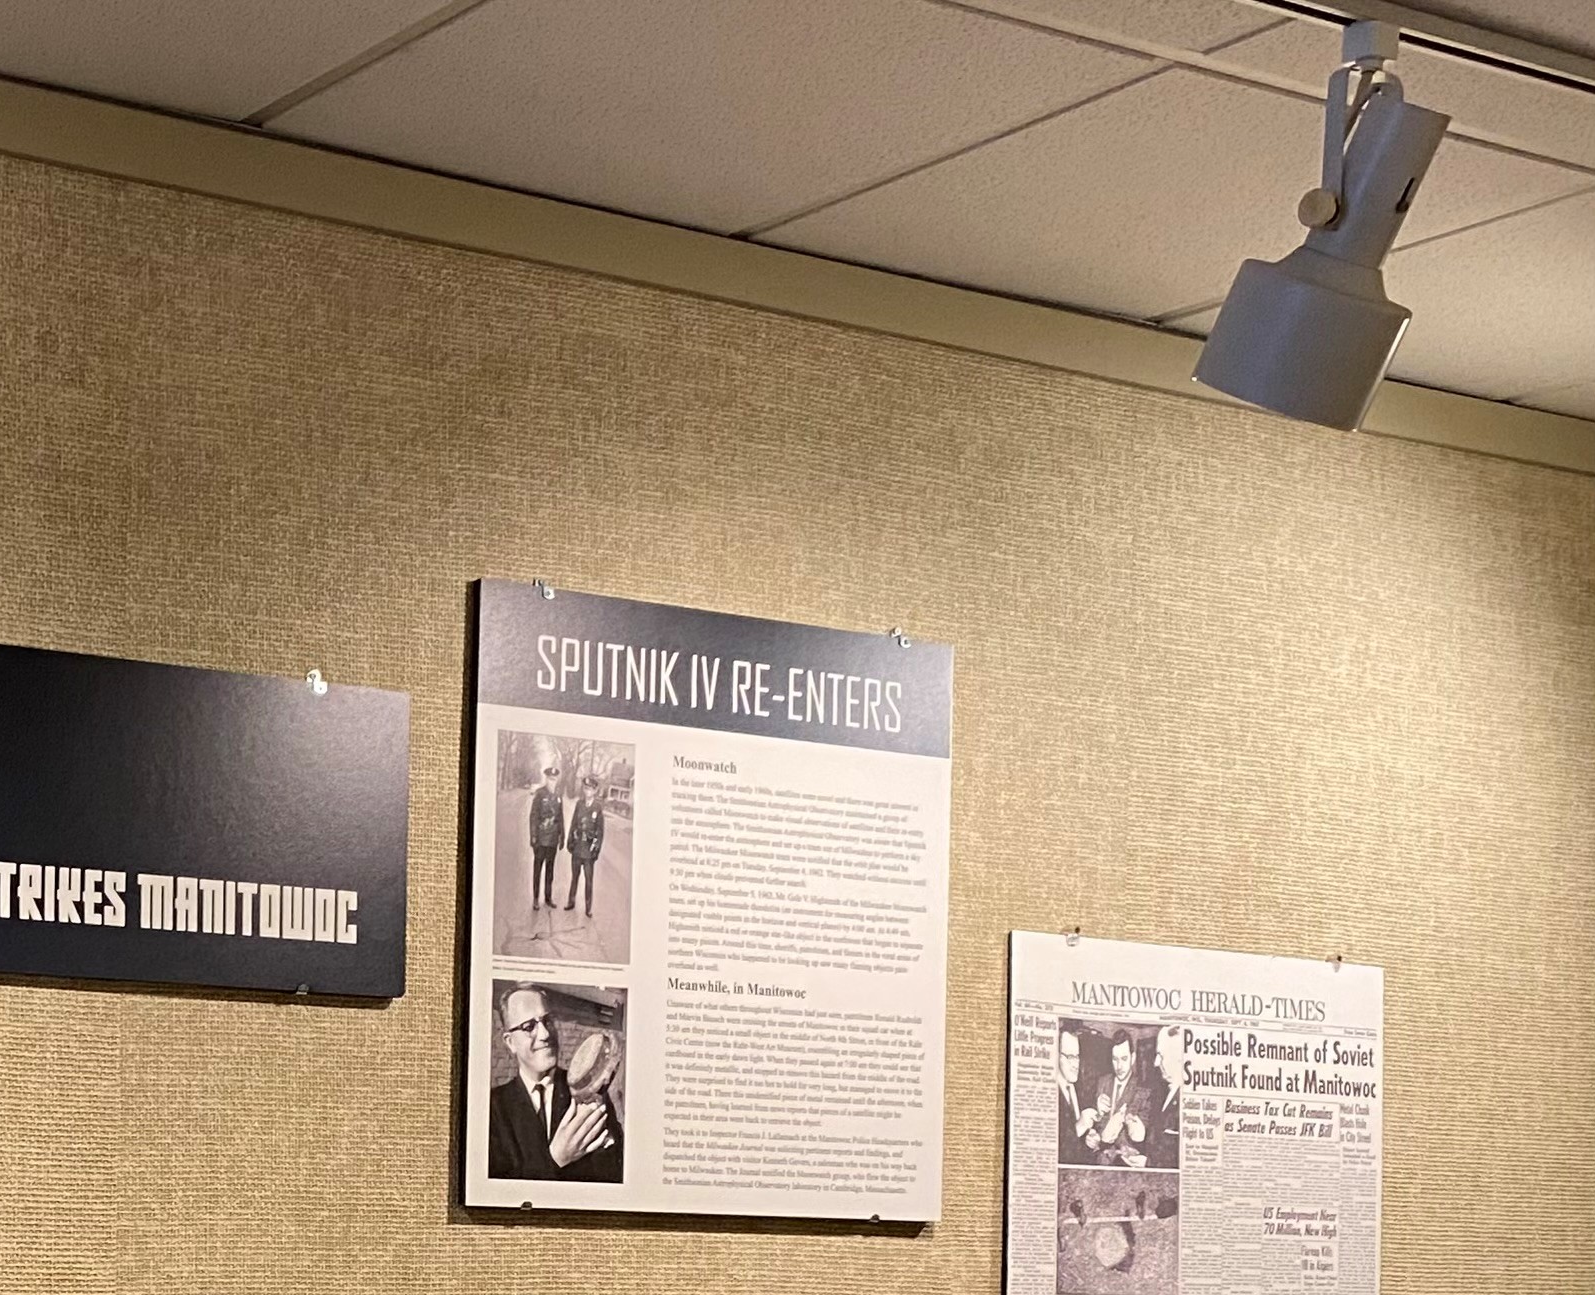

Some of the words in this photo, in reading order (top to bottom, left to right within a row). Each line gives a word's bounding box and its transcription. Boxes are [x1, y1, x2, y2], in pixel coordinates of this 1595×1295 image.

[537, 635, 679, 707] SPUTNIK
[691, 655, 720, 711] IV
[732, 660, 901, 733] RE-ENTERS
[673, 755, 737, 774] Moonwatch
[137, 874, 359, 945] MANITOWOC
[667, 977, 730, 993] Meanwhile,
[733, 982, 743, 994] in
[747, 983, 806, 999] Manitowoc
[1071, 981, 1181, 1010] MANITOWOC
[1191, 990, 1325, 1021] HERALD-TIMES
[1183, 1029, 1241, 1056] Possible
[1247, 1033, 1309, 1062] Remnant
[1313, 1039, 1327, 1064] of
[1332, 1040, 1374, 1067] Soviet
[1183, 1060, 1237, 1091] Sputnik
[1241, 1064, 1282, 1091] Found
[1285, 1073, 1299, 1093] at
[1303, 1069, 1376, 1098] Manitowoc
[1223, 1122, 1234, 1132] as
[1236, 1118, 1265, 1134] Senate
[1268, 1120, 1297, 1136] Passes
[1299, 1122, 1316, 1137] JFK
[1317, 1123, 1333, 1138] Bill
[1224, 1099, 1260, 1115] Business
[1263, 1101, 1279, 1116] Tax
[1282, 1102, 1296, 1117] Cut
[1298, 1104, 1333, 1120] Remains
